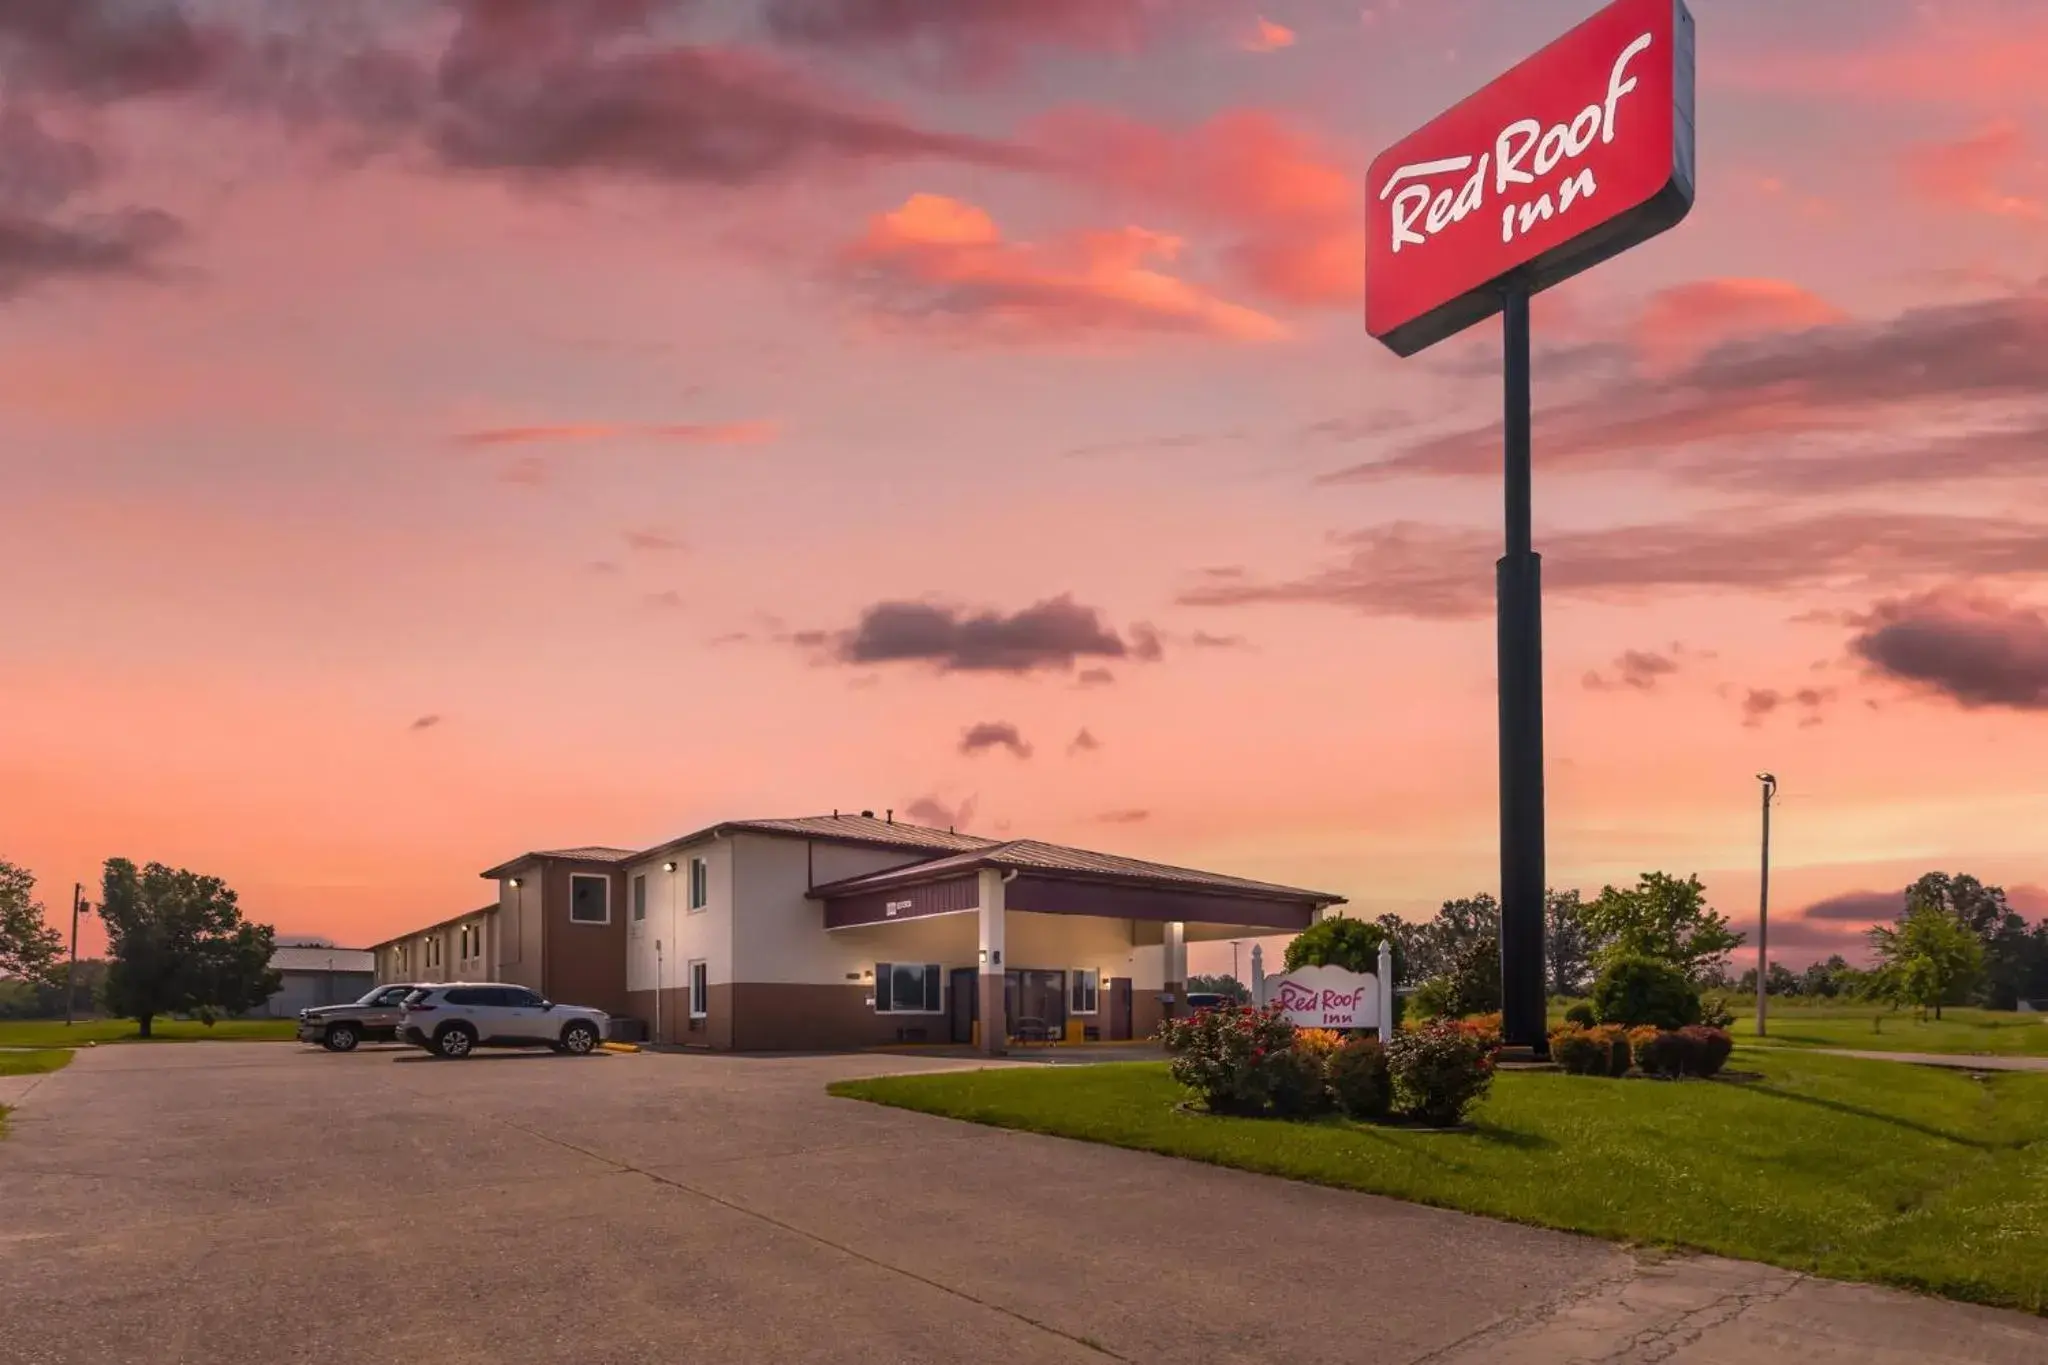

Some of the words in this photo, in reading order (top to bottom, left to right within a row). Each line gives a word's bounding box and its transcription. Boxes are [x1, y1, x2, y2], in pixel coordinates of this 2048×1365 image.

[1391, 153, 1489, 253] Red
[1495, 32, 1652, 194] Roof
[1502, 167, 1597, 243] Inn
[1281, 988, 1319, 1012] Red
[1322, 986, 1365, 1011] Roof
[1323, 1013, 1353, 1024] Inn
